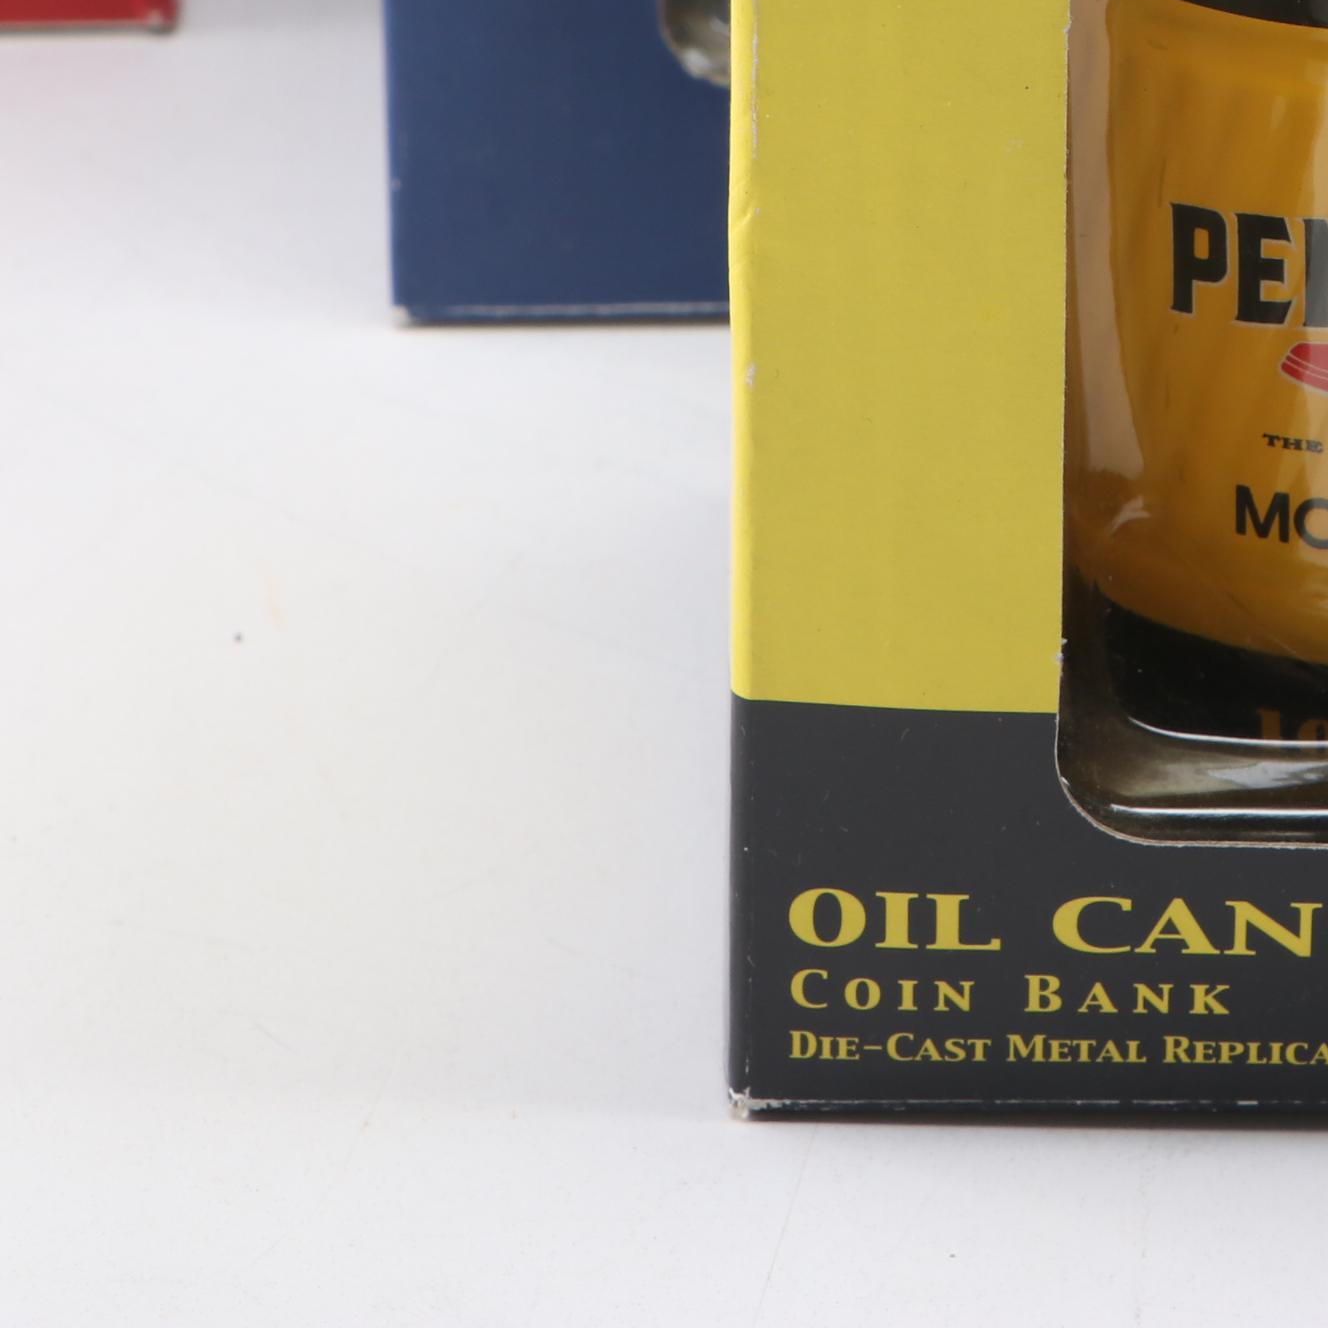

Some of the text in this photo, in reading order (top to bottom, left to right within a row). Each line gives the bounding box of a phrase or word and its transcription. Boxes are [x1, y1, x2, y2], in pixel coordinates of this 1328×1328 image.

[1262, 433, 1324, 454] THE
[788, 887, 1323, 958] OIL CAN
